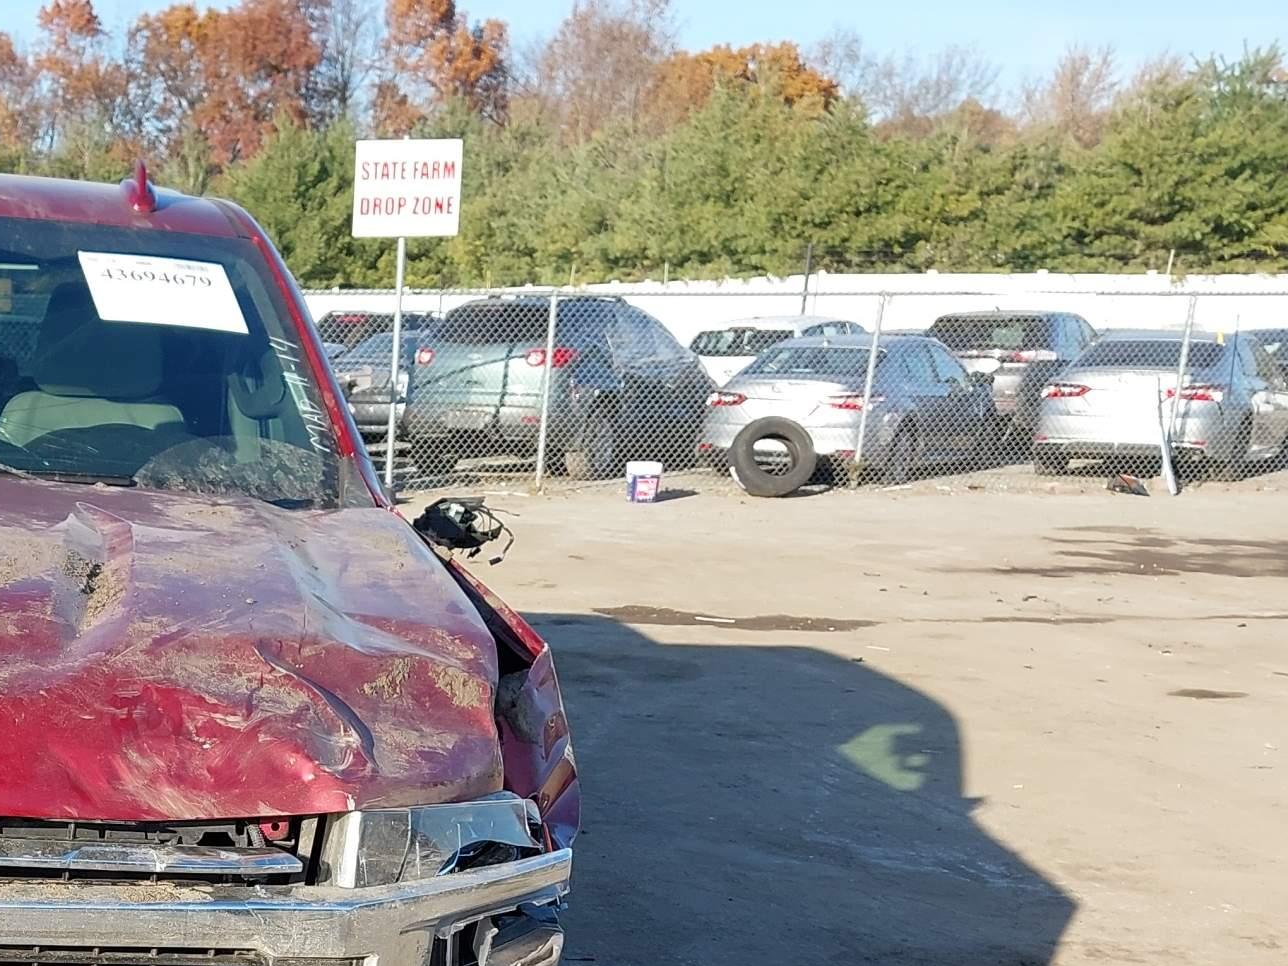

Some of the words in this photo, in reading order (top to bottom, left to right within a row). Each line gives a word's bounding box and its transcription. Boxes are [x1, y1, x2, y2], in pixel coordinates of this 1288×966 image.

[361, 160, 408, 181] STATE
[413, 160, 456, 180] FARM
[360, 197, 407, 216] DROP
[412, 196, 455, 215] ZONE
[100, 267, 213, 288] 43694679
